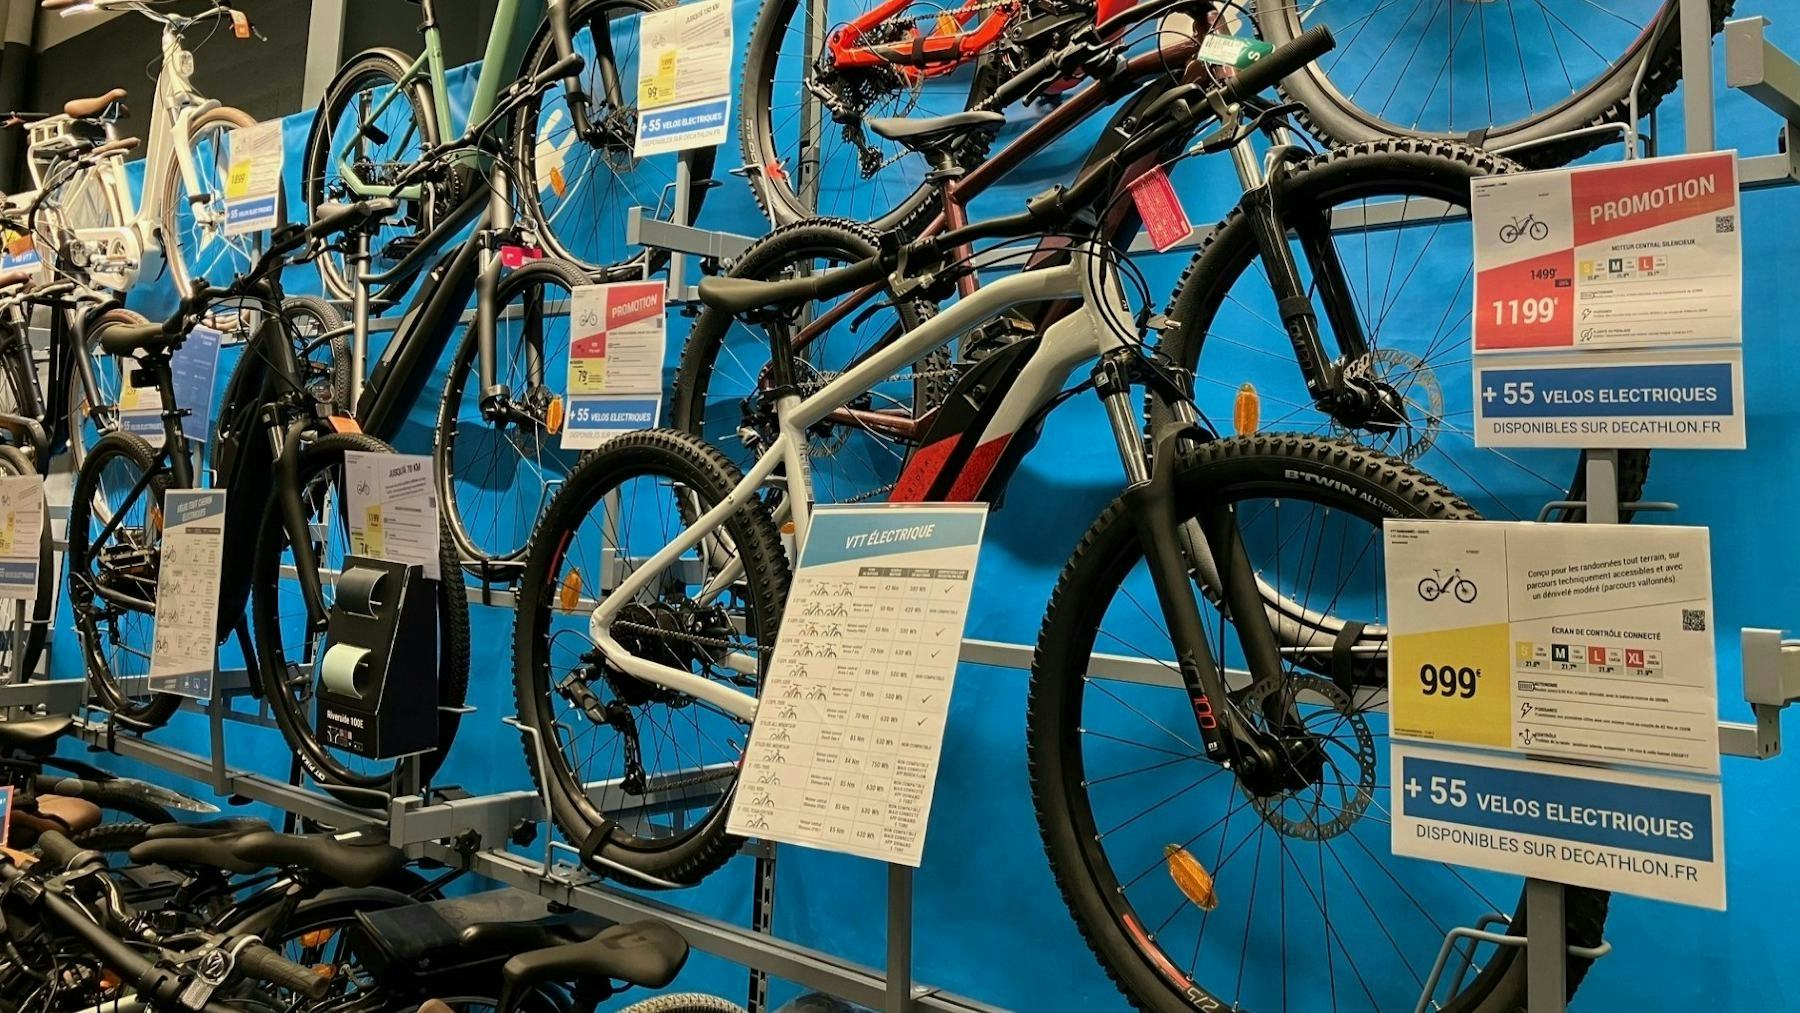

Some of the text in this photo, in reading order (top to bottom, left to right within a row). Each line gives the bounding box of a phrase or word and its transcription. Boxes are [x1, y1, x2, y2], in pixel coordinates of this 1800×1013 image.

[1247, 50, 1261, 61] S
[648, 118, 661, 132] 55
[662, 119, 681, 129] VELOS
[682, 112, 722, 127] ELECTRIQUES
[1590, 174, 1716, 226] PROMOTION
[1611, 239, 1696, 251] MOTEUR CENTRAL SILENCIEUX
[1583, 263, 1590, 273] S
[1611, 261, 1621, 270] M
[1643, 258, 1650, 269] L
[611, 293, 658, 319] PROMOTION
[1483, 382, 1718, 405] + 55 VELOS ELECTRIQUES
[576, 407, 590, 422] 55
[590, 412, 610, 422] VELOS
[610, 412, 652, 422] ELECTRIQUES
[1493, 420, 1721, 434] DISPONIBLES SUR DECATHLON.FR
[845, 523, 936, 550] VTT ÉLECTRIQUE
[1528, 569, 1550, 579] Conçu
[1551, 567, 1567, 577] pour
[1568, 565, 1579, 573] les
[1580, 559, 1622, 571] randonnées
[1623, 556, 1639, 565] tout
[1640, 553, 1667, 563] terrain,
[1527, 564, 1683, 591] parcours techniquement accessibles et avec
[1542, 586, 1572, 599] dénivelé
[1573, 584, 1600, 595] modéré
[1601, 581, 1636, 593] (parcours
[1638, 574, 1676, 586] vallonnés)
[1551, 626, 1661, 640] ÉCRAN DE CONTRÔLE CONNECTÉ
[1556, 648, 1565, 659] M
[1594, 650, 1601, 661] L
[1627, 652, 1643, 665] XL
[1419, 663, 1482, 699] 999€
[326, 709, 364, 729] Riverside 100E
[1193, 694, 1217, 729] 100
[1404, 776, 1694, 840] + 55 VELOS ELECTRIQUES
[1416, 824, 1698, 882] DISPONIBLES SUR DECATHLON.FR
